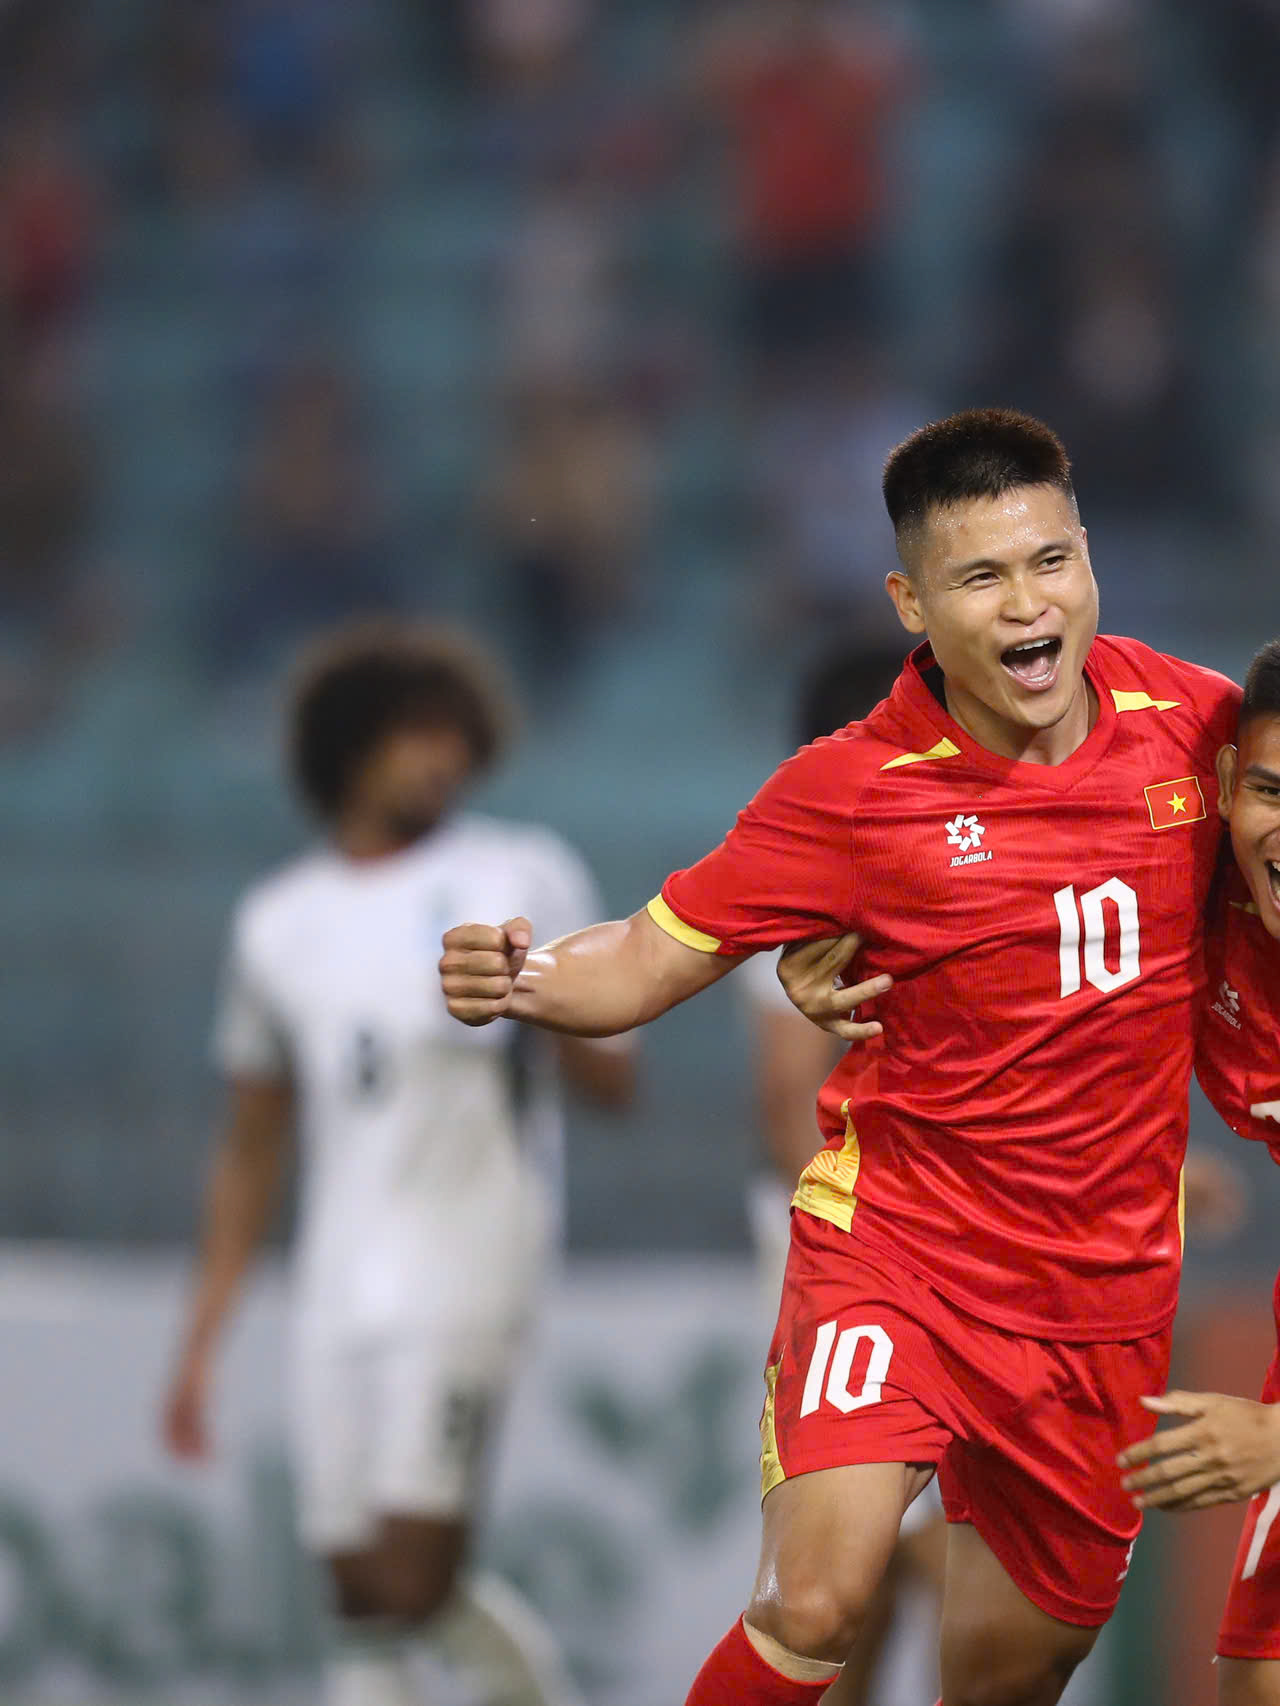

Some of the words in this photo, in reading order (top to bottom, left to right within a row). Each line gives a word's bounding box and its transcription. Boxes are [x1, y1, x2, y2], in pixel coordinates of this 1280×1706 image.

[949, 850, 993, 868] JOGARBOLA
[1053, 876, 1141, 999] 10
[800, 1320, 894, 1419] 10
